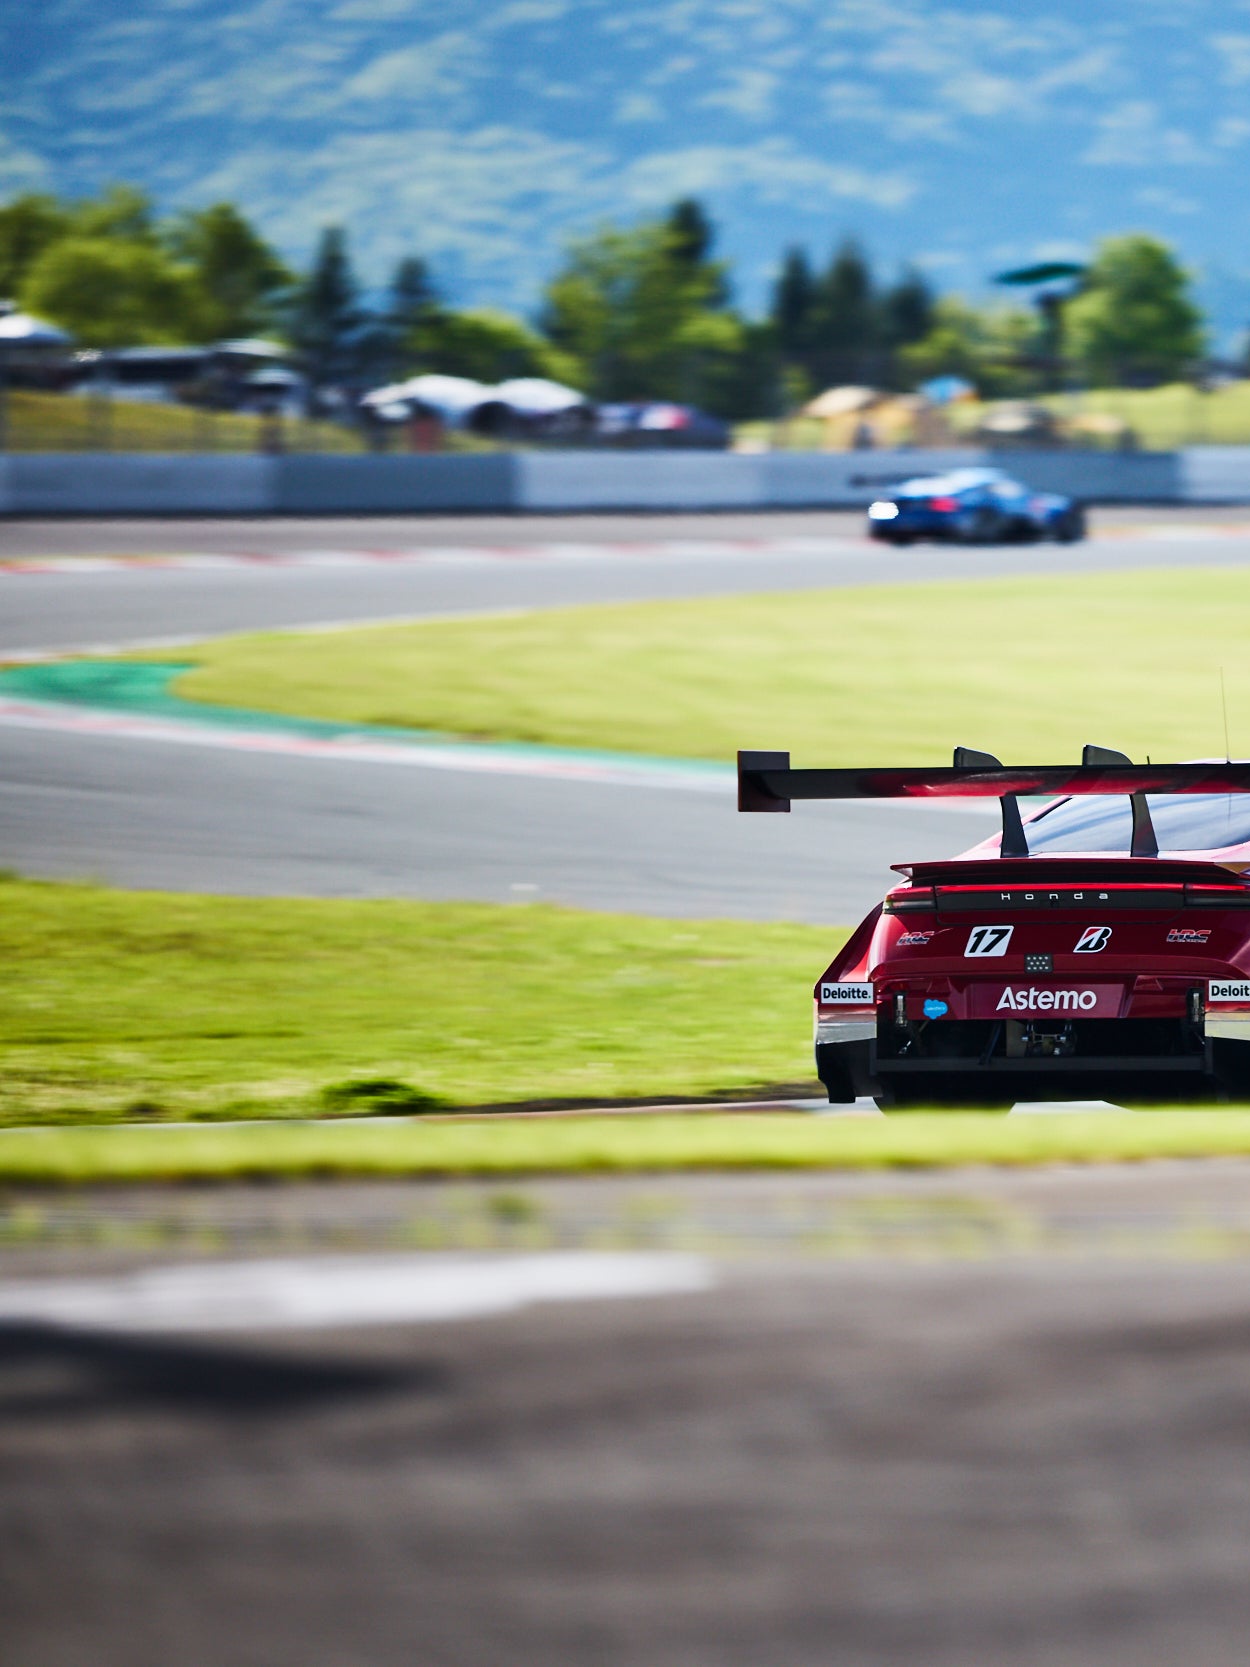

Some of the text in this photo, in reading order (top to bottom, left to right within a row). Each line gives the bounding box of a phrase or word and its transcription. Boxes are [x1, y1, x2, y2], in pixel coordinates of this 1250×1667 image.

[1001, 892, 1108, 900] Honda
[968, 929, 1011, 954] 17
[823, 987, 872, 999] Deloitte.
[995, 986, 1097, 1011] Astemo
